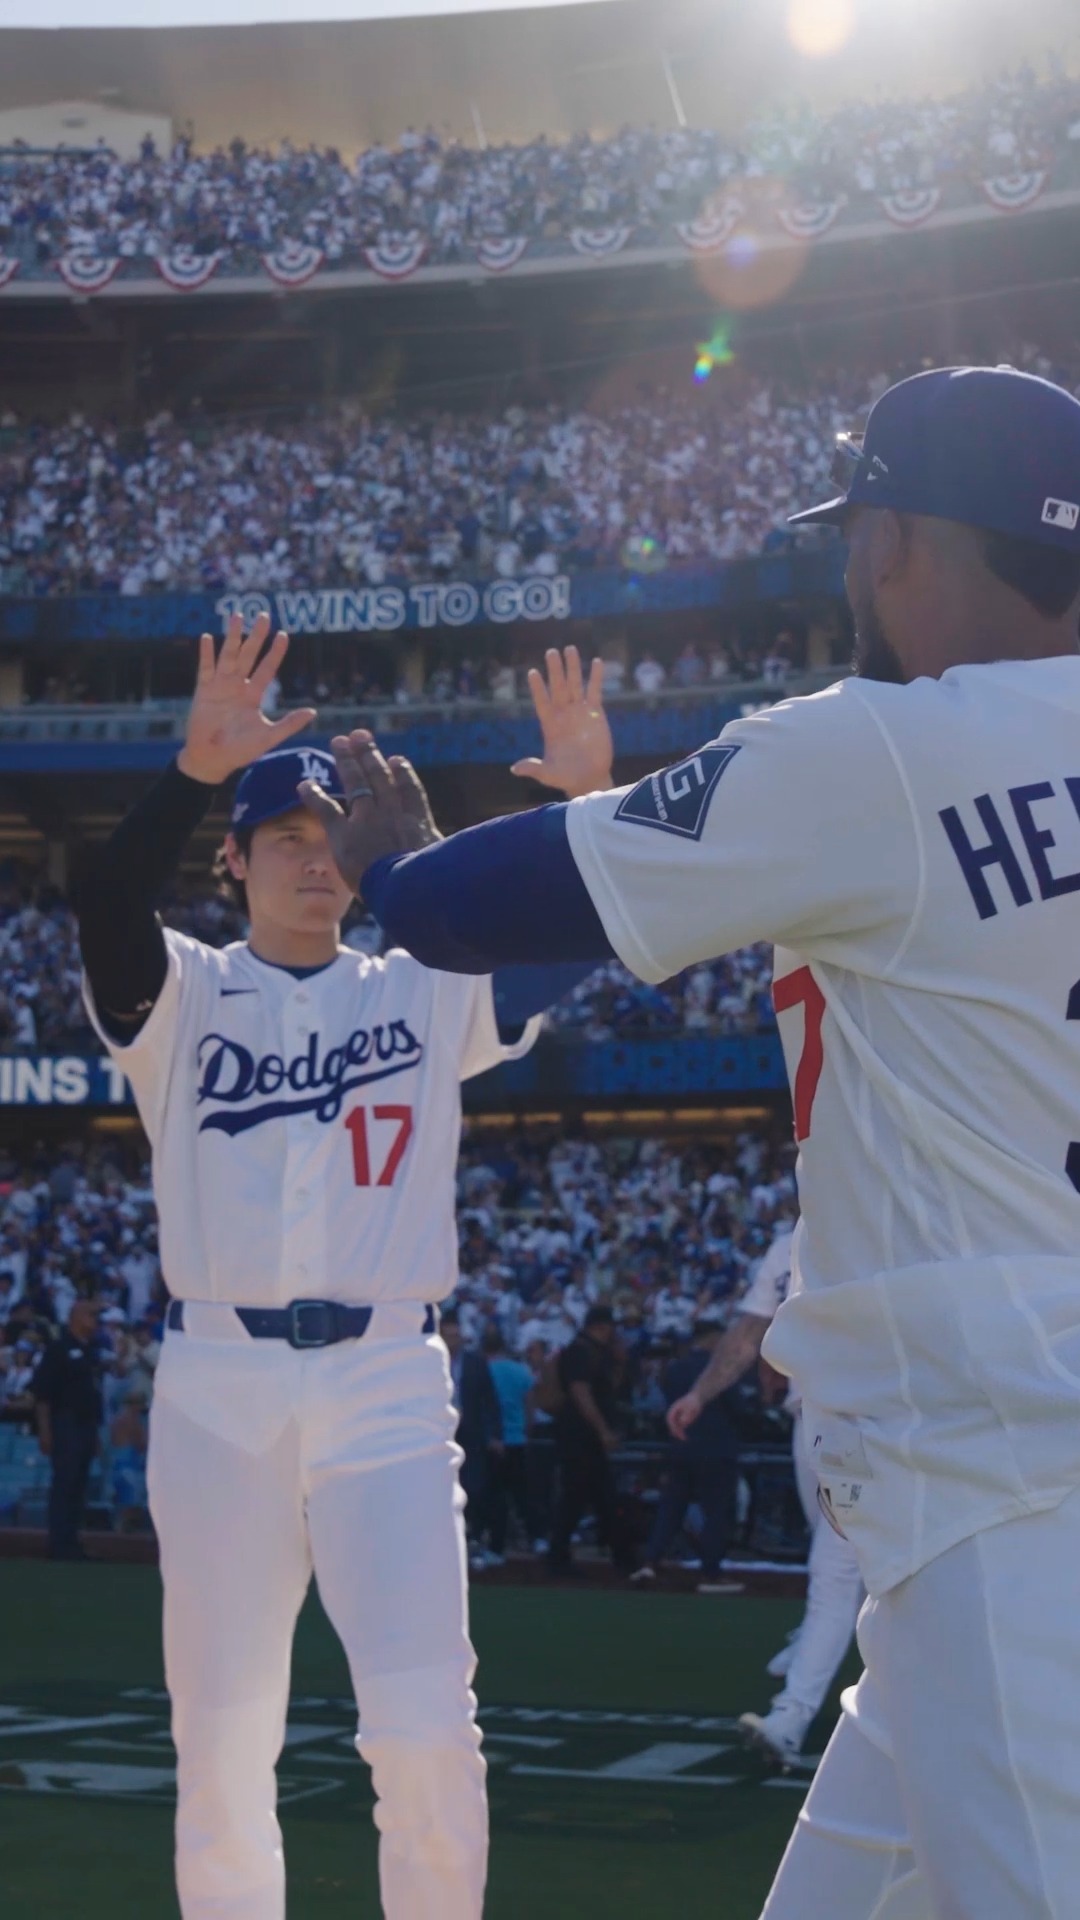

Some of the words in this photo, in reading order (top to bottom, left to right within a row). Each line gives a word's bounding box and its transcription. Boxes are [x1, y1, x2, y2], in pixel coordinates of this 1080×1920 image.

[275, 586, 406, 634] WINS
[409, 581, 480, 628] TO
[483, 575, 571, 624] GO!
[297, 752, 332, 787] LA
[938, 776, 1080, 920] HE
[197, 1019, 423, 1136] Dodgers
[344, 1104, 414, 1188] 17
